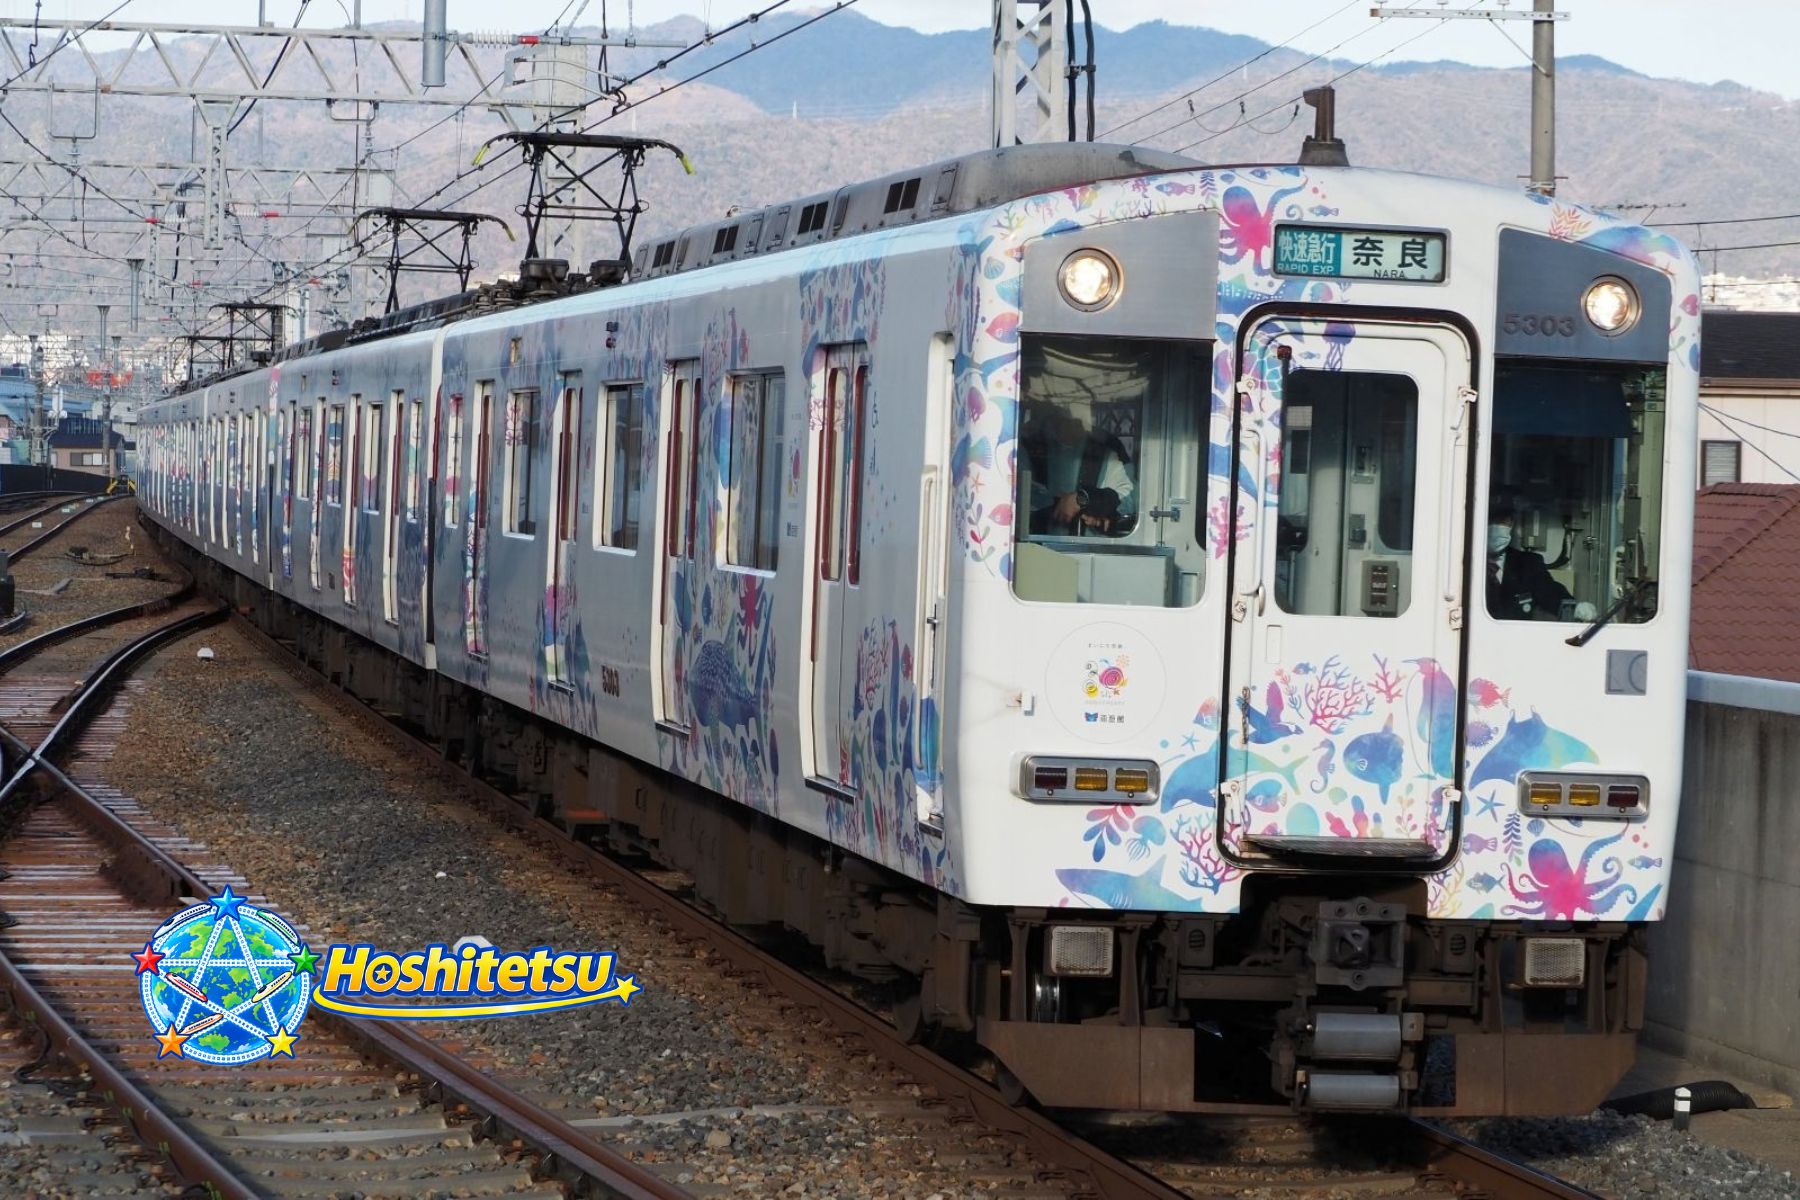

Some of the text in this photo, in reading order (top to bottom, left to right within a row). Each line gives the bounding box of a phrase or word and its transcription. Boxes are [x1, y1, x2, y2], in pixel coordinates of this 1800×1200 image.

[1278, 230, 1336, 264] 快速急行
[1352, 236, 1428, 269] 奈良
[1277, 263, 1308, 273] RAPID
[1373, 268, 1406, 279] NARA
[1503, 313, 1576, 337] 5303
